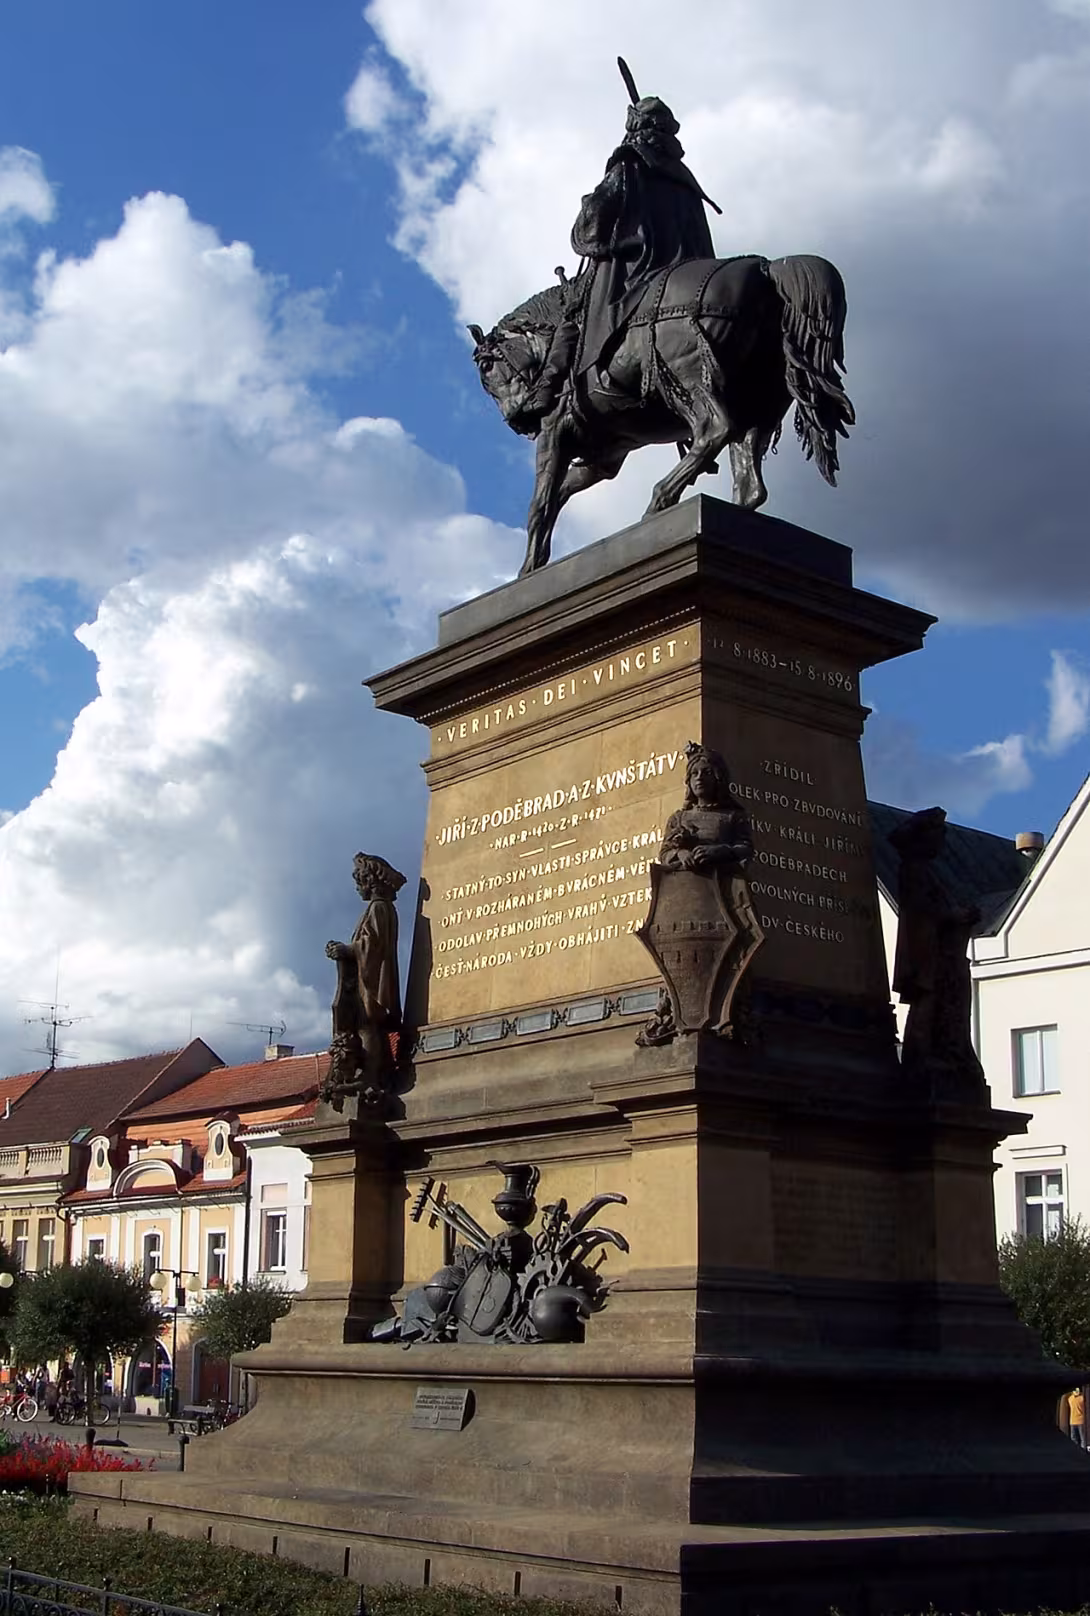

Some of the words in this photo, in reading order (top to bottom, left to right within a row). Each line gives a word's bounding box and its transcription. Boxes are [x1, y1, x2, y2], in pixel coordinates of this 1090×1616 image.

[447, 700, 526, 742] VERITAS
[543, 679, 576, 706] DEI
[593, 640, 677, 685] VINCET
[764, 791, 789, 808] PRO
[531, 855, 571, 878] VLASTI
